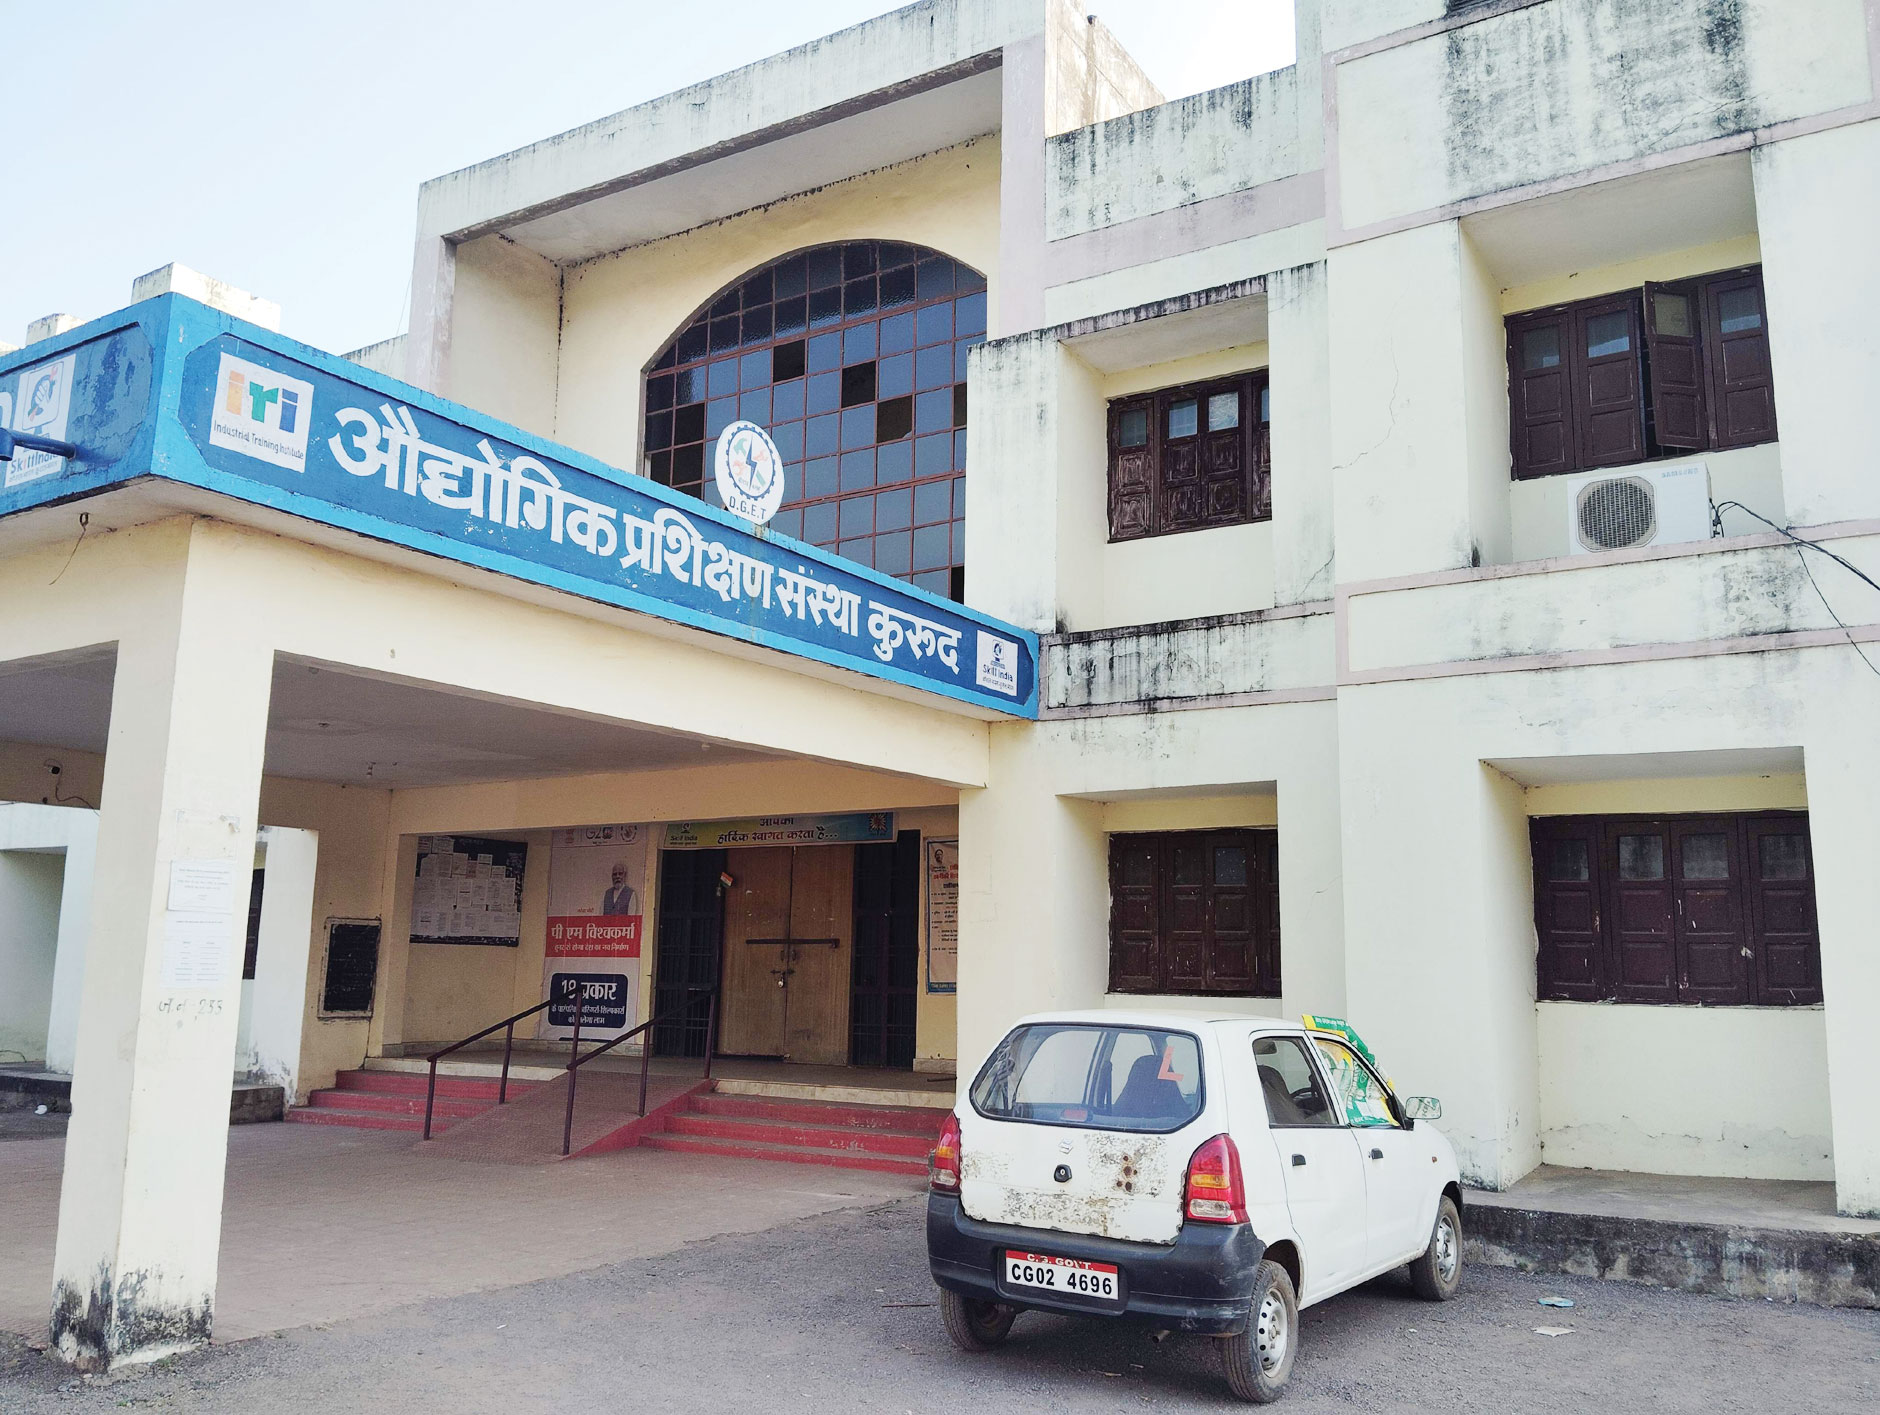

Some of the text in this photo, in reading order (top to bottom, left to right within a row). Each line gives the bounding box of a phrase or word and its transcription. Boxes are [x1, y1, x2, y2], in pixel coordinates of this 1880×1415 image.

[213, 420, 250, 442] Industrial
[251, 433, 279, 454] Training
[729, 495, 767, 520] D.G.E.T
[327, 402, 963, 675] औद्योगिक प्रशिक्षण संस्था कुरूद
[717, 830, 749, 845] हार्दिक
[751, 831, 783, 842] स्वागत
[787, 829, 814, 840] करता
[551, 922, 636, 940] पी एम विश्वकर्मा
[1011, 1263, 1113, 1295] CG02 4696
